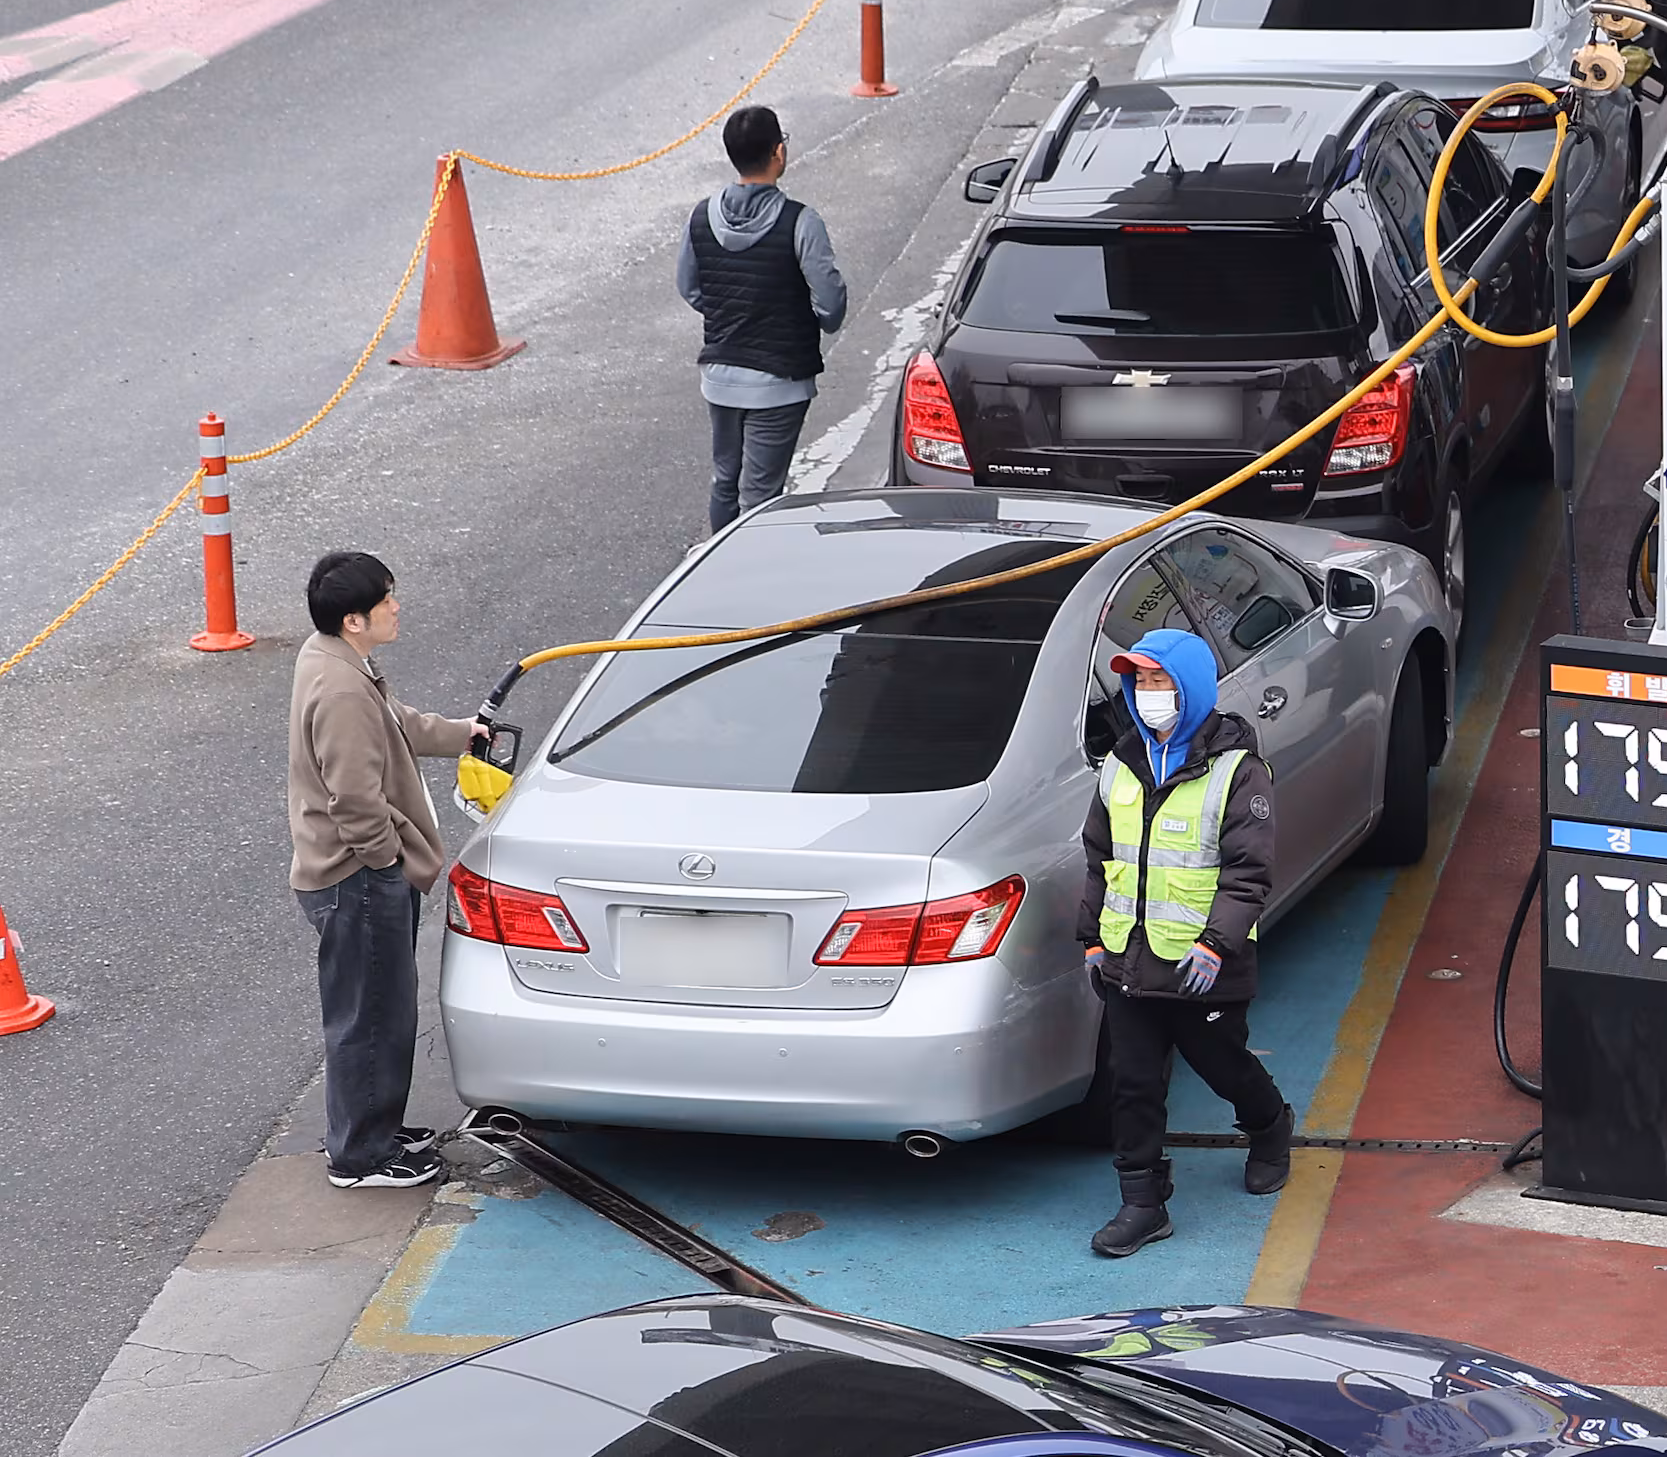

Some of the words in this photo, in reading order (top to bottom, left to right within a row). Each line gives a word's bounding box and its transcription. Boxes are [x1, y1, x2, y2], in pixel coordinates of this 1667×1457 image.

[988, 463, 1052, 477] CHEVROLET
[1259, 469, 1287, 479] RAX
[515, 957, 575, 972] LEXUS
[831, 976, 855, 988] ES
[858, 976, 895, 989] 350
